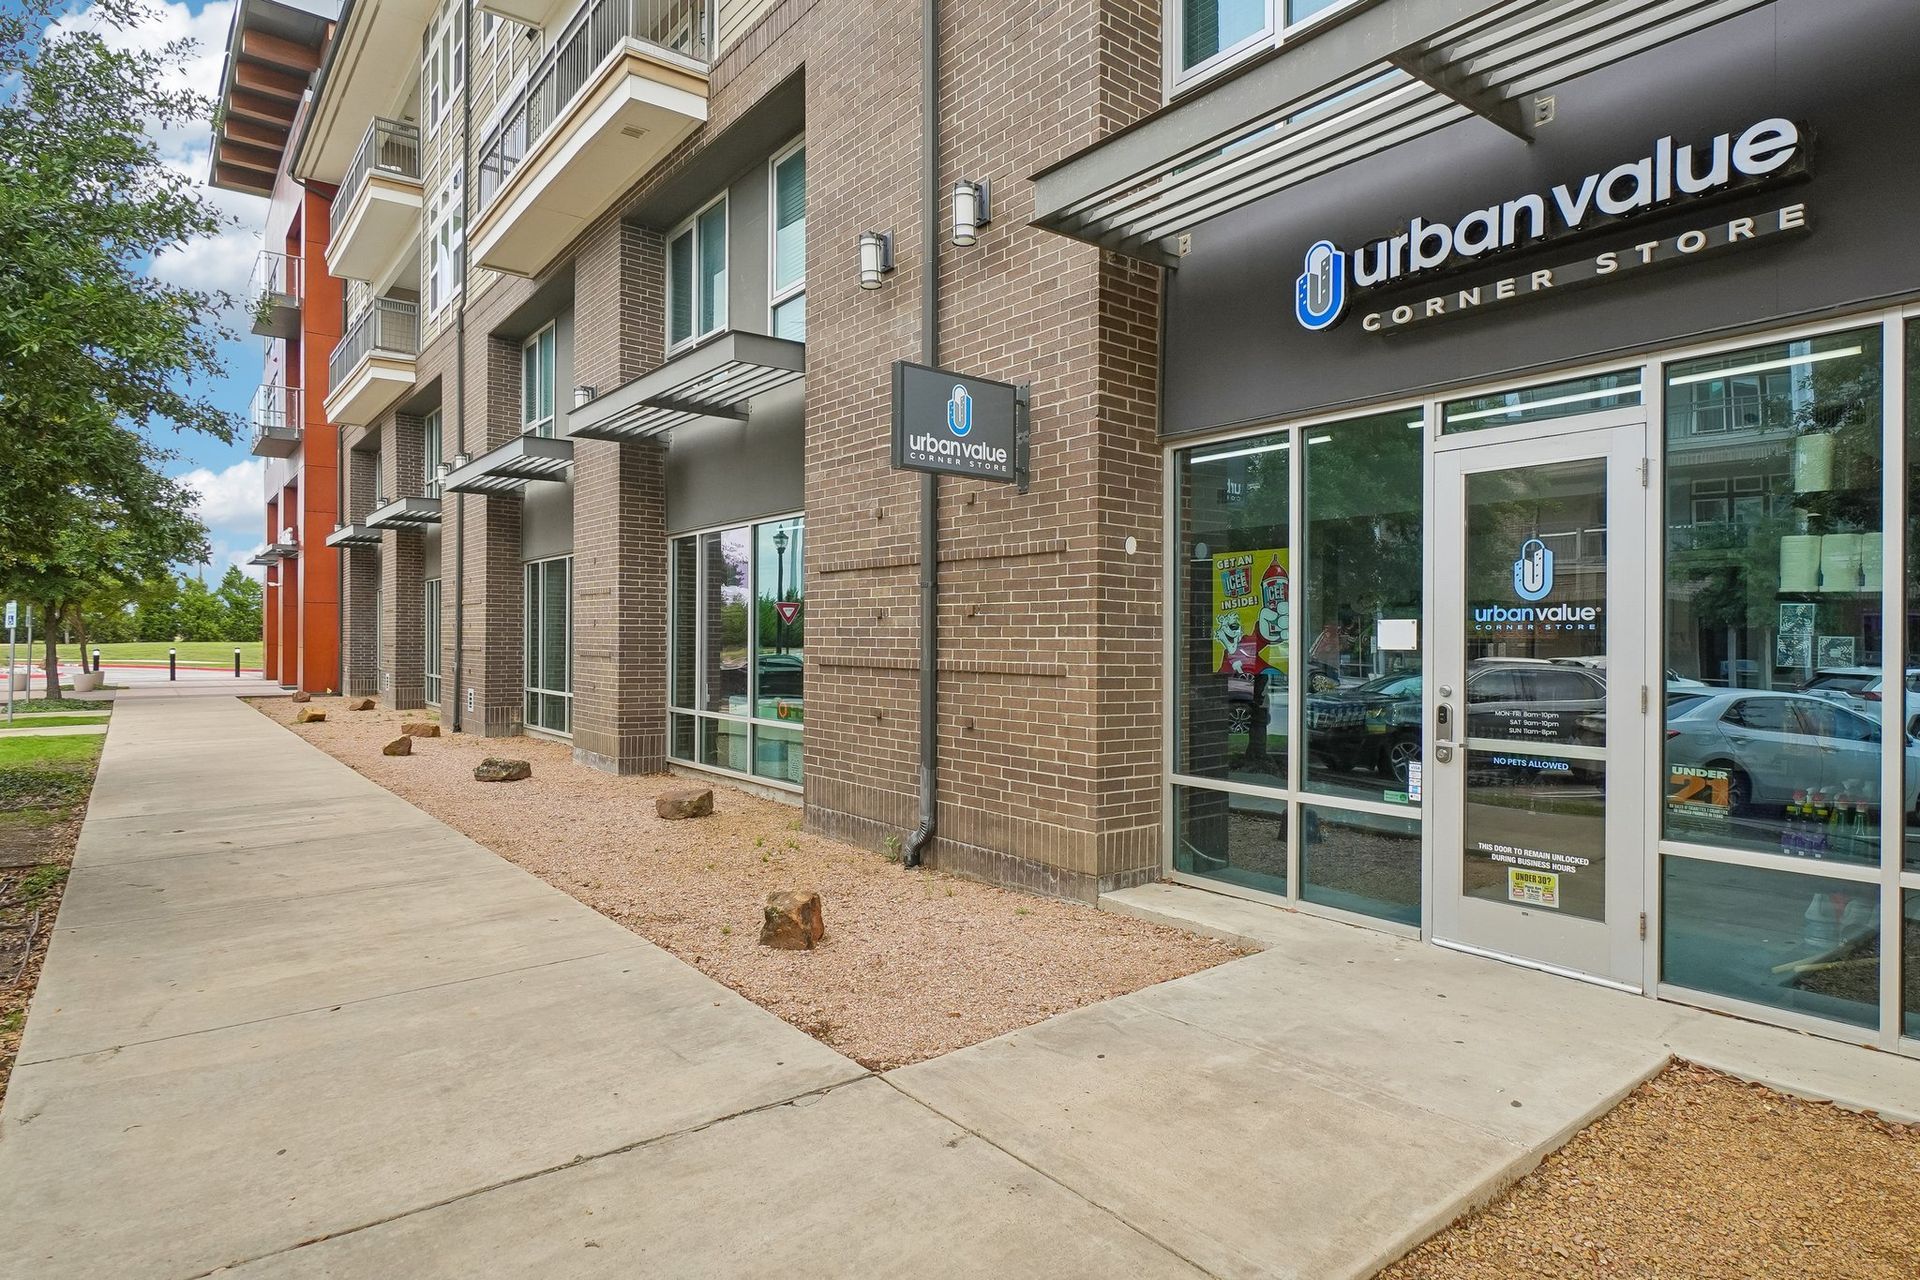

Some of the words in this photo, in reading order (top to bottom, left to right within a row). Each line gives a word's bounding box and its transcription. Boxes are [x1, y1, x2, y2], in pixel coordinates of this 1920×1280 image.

[1362, 268, 1554, 332] CORNER
[1596, 202, 1805, 274] STORE
[910, 452, 961, 465] CORNER
[970, 461, 1006, 472] STORE
[1216, 558, 1236, 570] GET
[1238, 555, 1253, 566] AN
[1226, 574, 1248, 590] ICEE
[1266, 584, 1285, 600] ICEE
[1221, 596, 1258, 610] INSIDE!
[1523, 711, 1559, 719] 8am-10pm
[1523, 728, 1558, 736] 11am-8pm
[1528, 761, 1568, 770] ALLOWED
[1672, 766, 1728, 780] UNDER
[1669, 775, 1728, 805] 21
[1478, 842, 1493, 851] THIS
[1494, 845, 1512, 854] DOOR
[1524, 849, 1550, 859] REMAIN
[1552, 853, 1589, 866] UNLOCKED
[1492, 854, 1516, 864] DURING
[1518, 858, 1550, 869] BUSINESS
[1552, 863, 1576, 873] HOURS
[1516, 872, 1536, 883] UNDER
[1538, 875, 1552, 885] 30?
